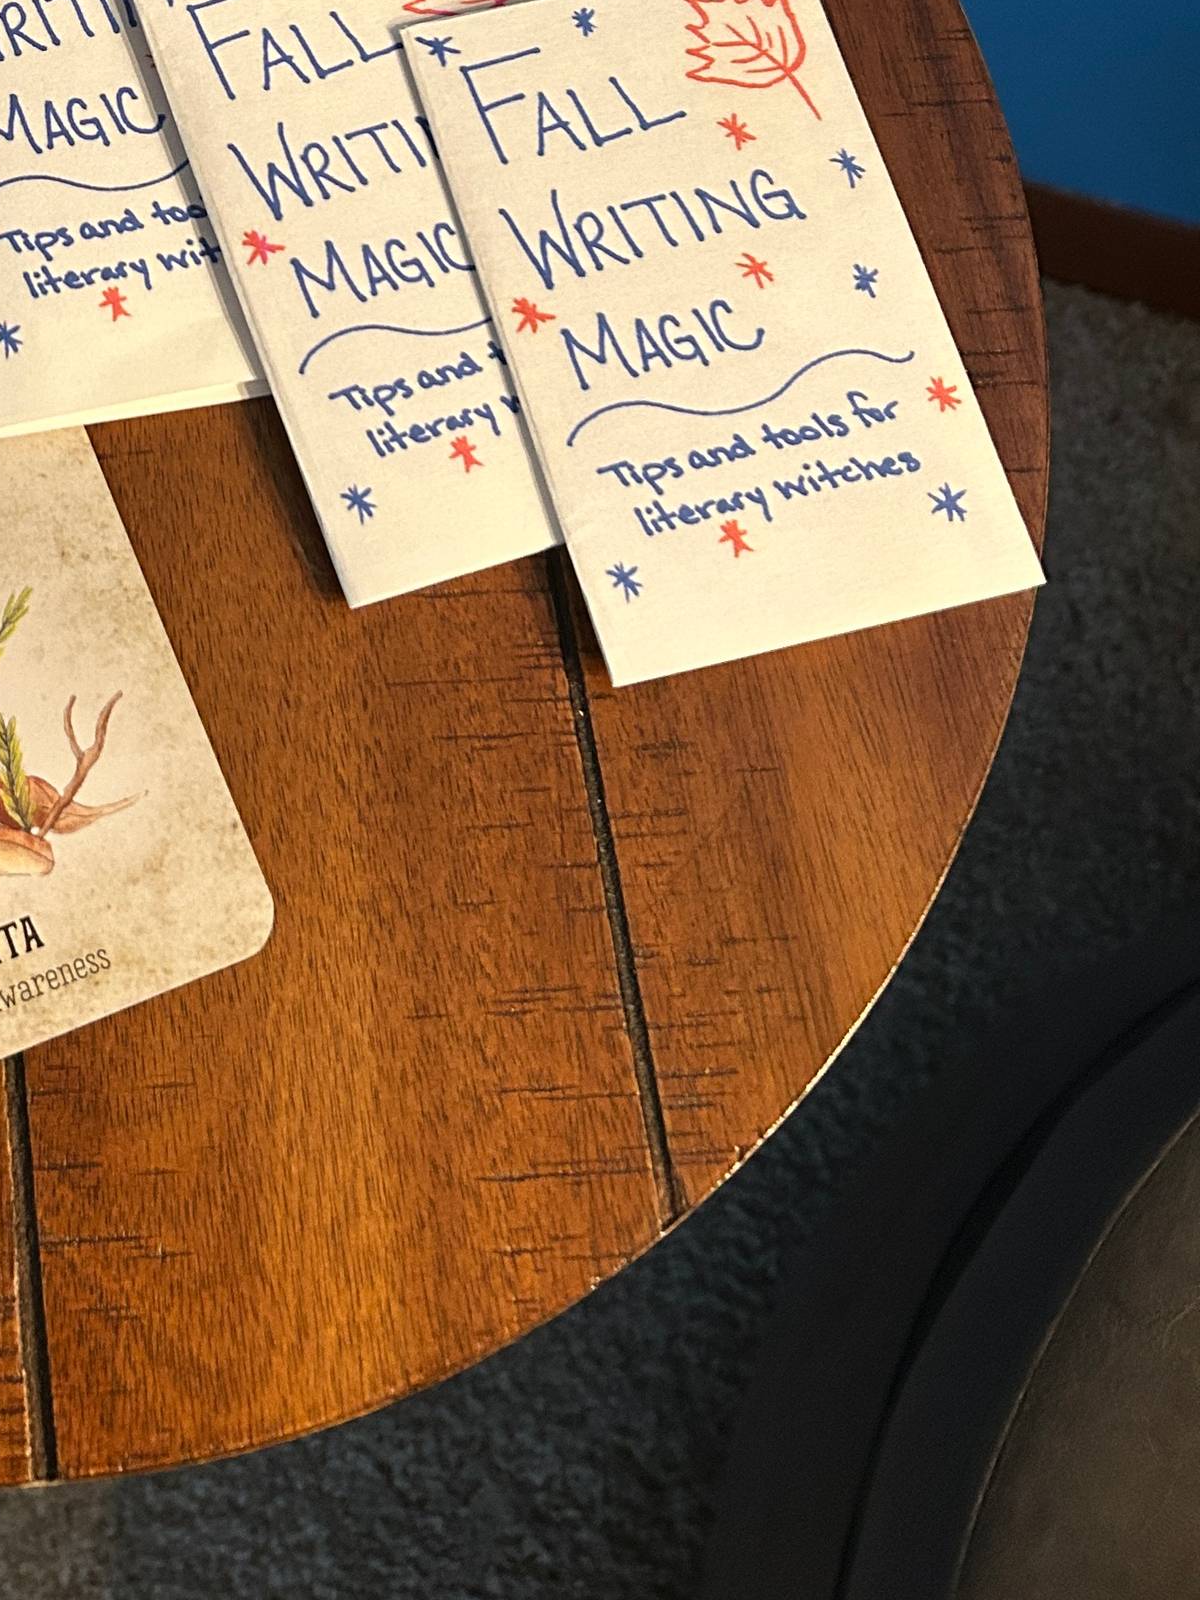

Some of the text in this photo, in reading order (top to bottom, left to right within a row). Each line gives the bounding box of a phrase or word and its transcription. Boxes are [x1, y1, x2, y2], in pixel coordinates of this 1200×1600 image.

[459, 46, 687, 165] FALL
[227, 115, 440, 221] WRITI
[79, 208, 145, 241] and
[152, 200, 208, 226] too
[498, 168, 808, 290] WRITING
[22, 258, 153, 300] literary
[290, 221, 476, 318] MAGIC
[328, 377, 414, 417] Tips
[417, 351, 483, 389] and
[559, 298, 766, 391] MAGIC
[365, 403, 501, 458] literary
[596, 391, 900, 495] Tips and tools for
[634, 450, 922, 537] literary witches
